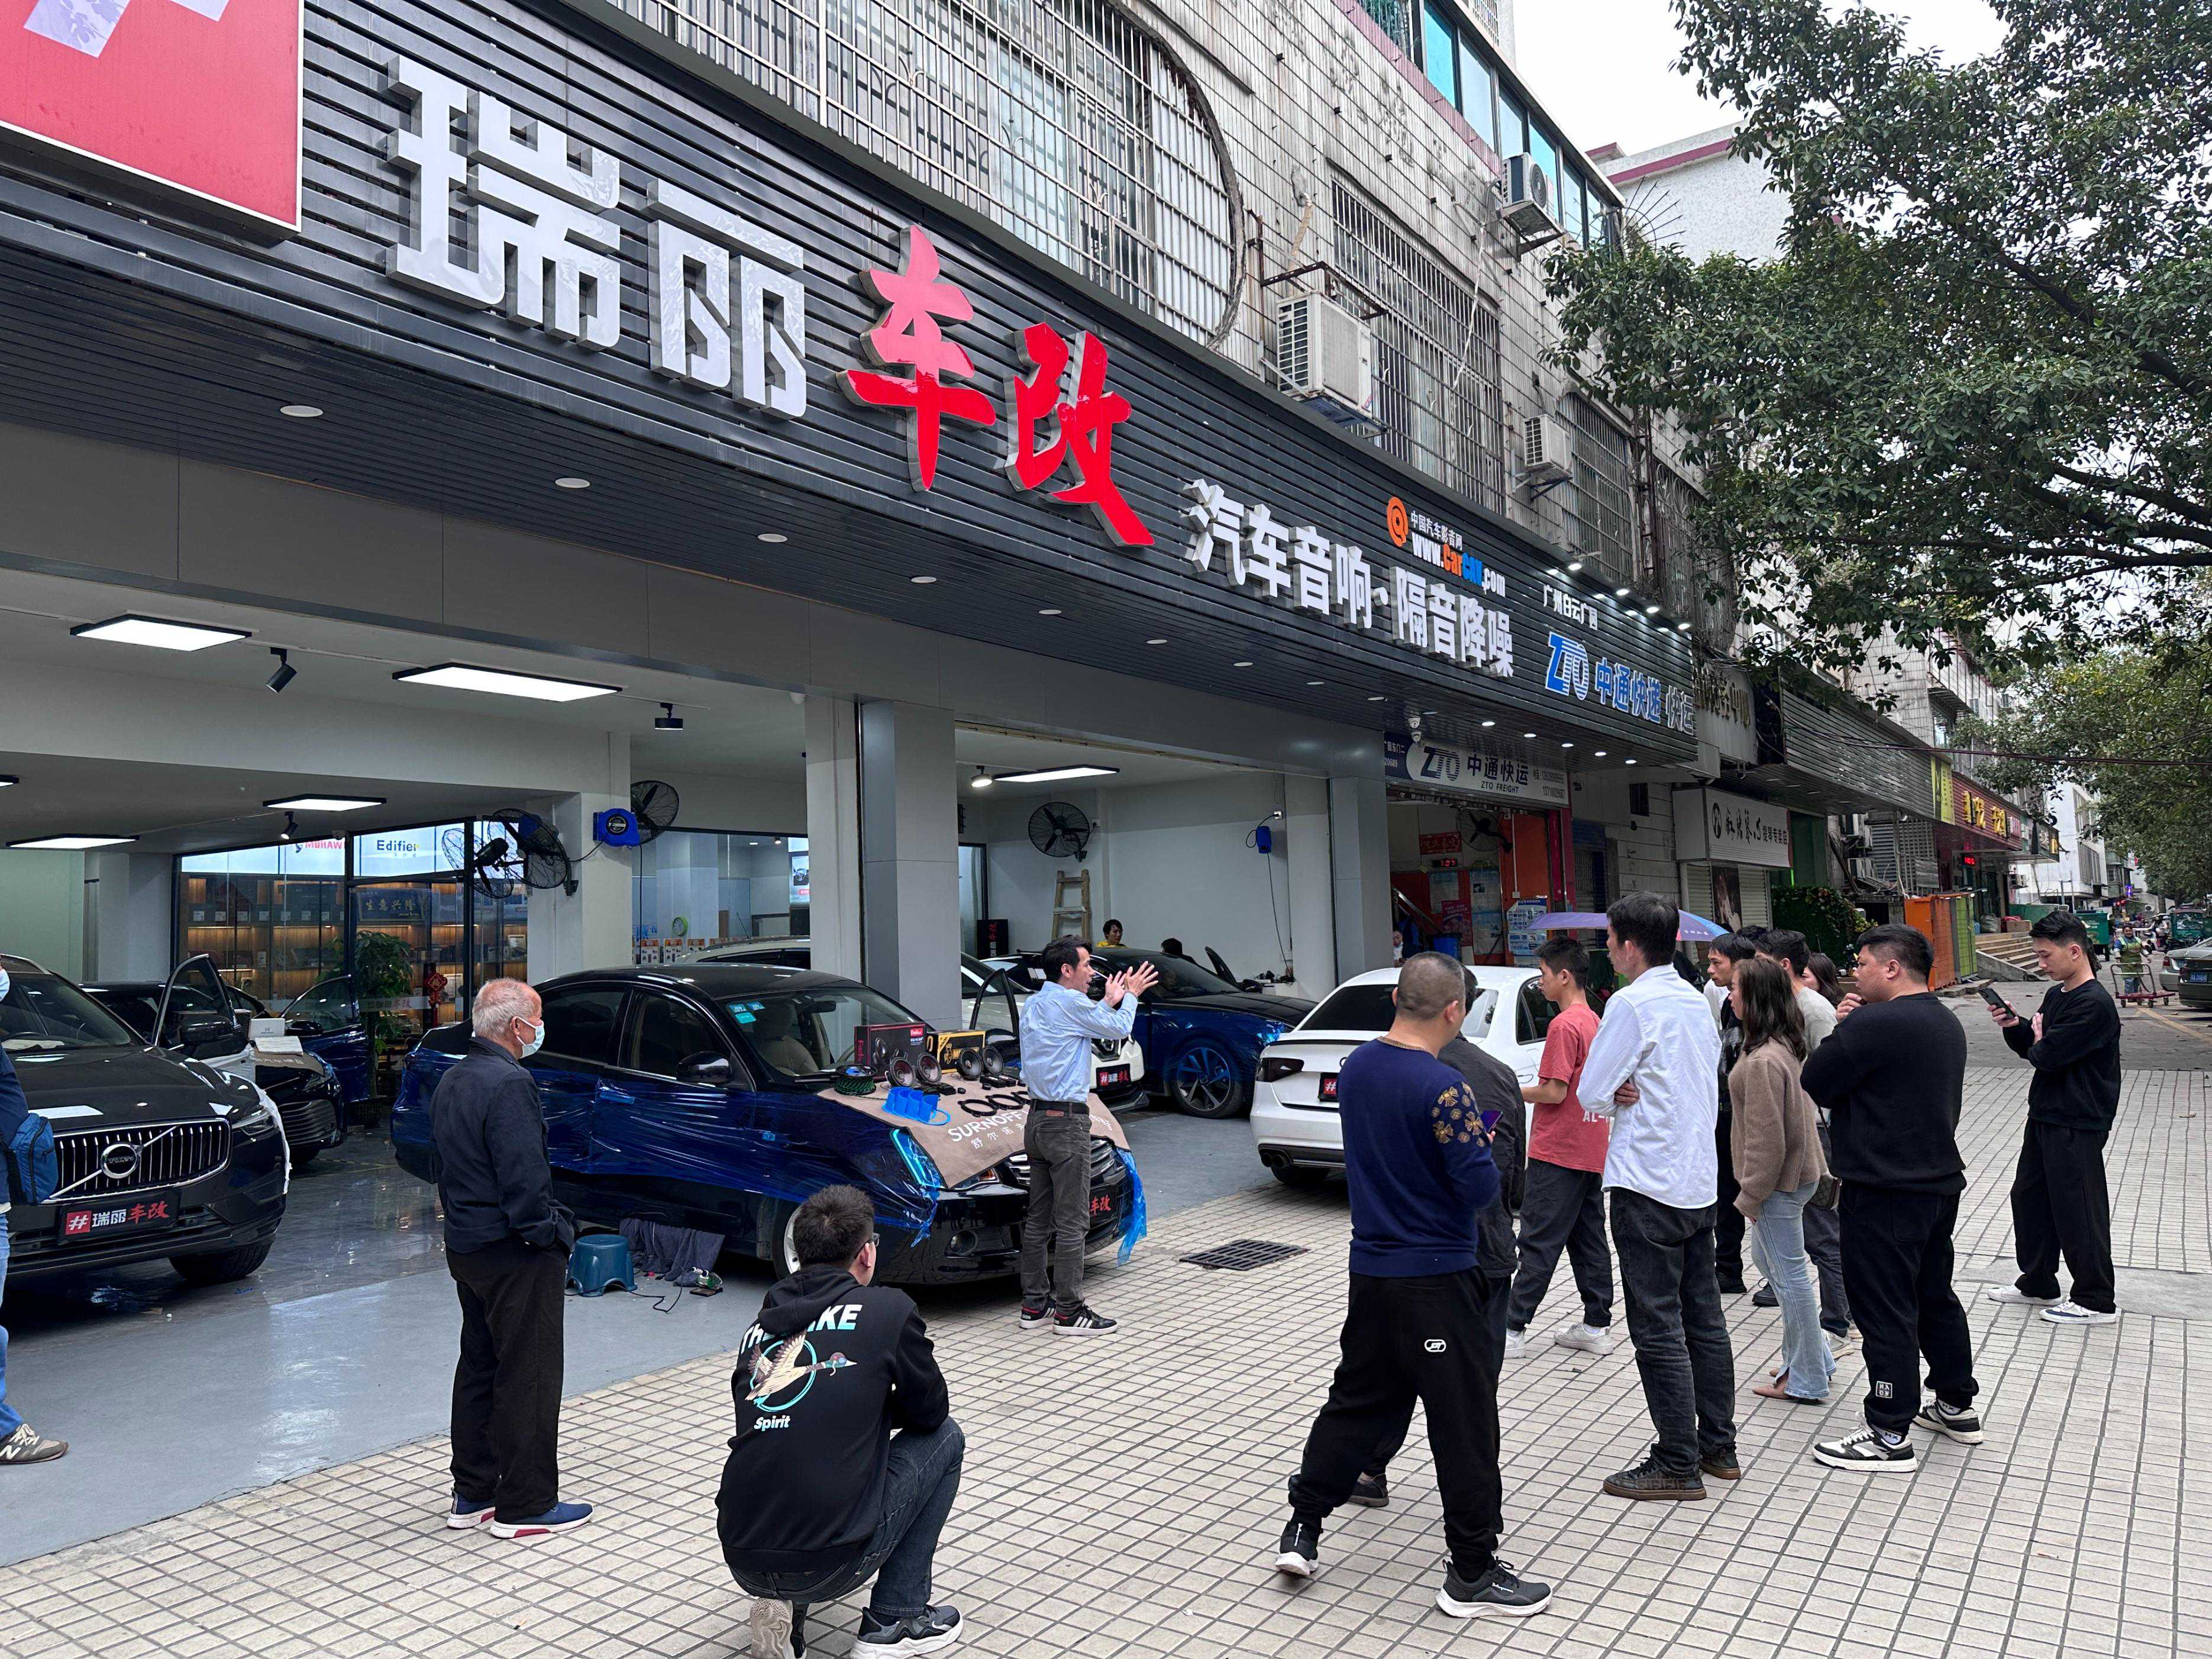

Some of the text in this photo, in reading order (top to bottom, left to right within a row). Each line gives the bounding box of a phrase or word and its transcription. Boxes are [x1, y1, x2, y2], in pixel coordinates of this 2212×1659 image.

[1410, 510, 1462, 551] 中国汽车影音网
[1545, 631, 1589, 701] ZTO
[1595, 657, 1661, 724] 中通快递
[1420, 746, 1461, 781] ZTO
[1467, 754, 1529, 786] 中通快运
[1481, 781, 1519, 793] ZTO FREIGHT
[377, 840, 417, 852] Edifier
[754, 1415, 791, 1432] Spirit
